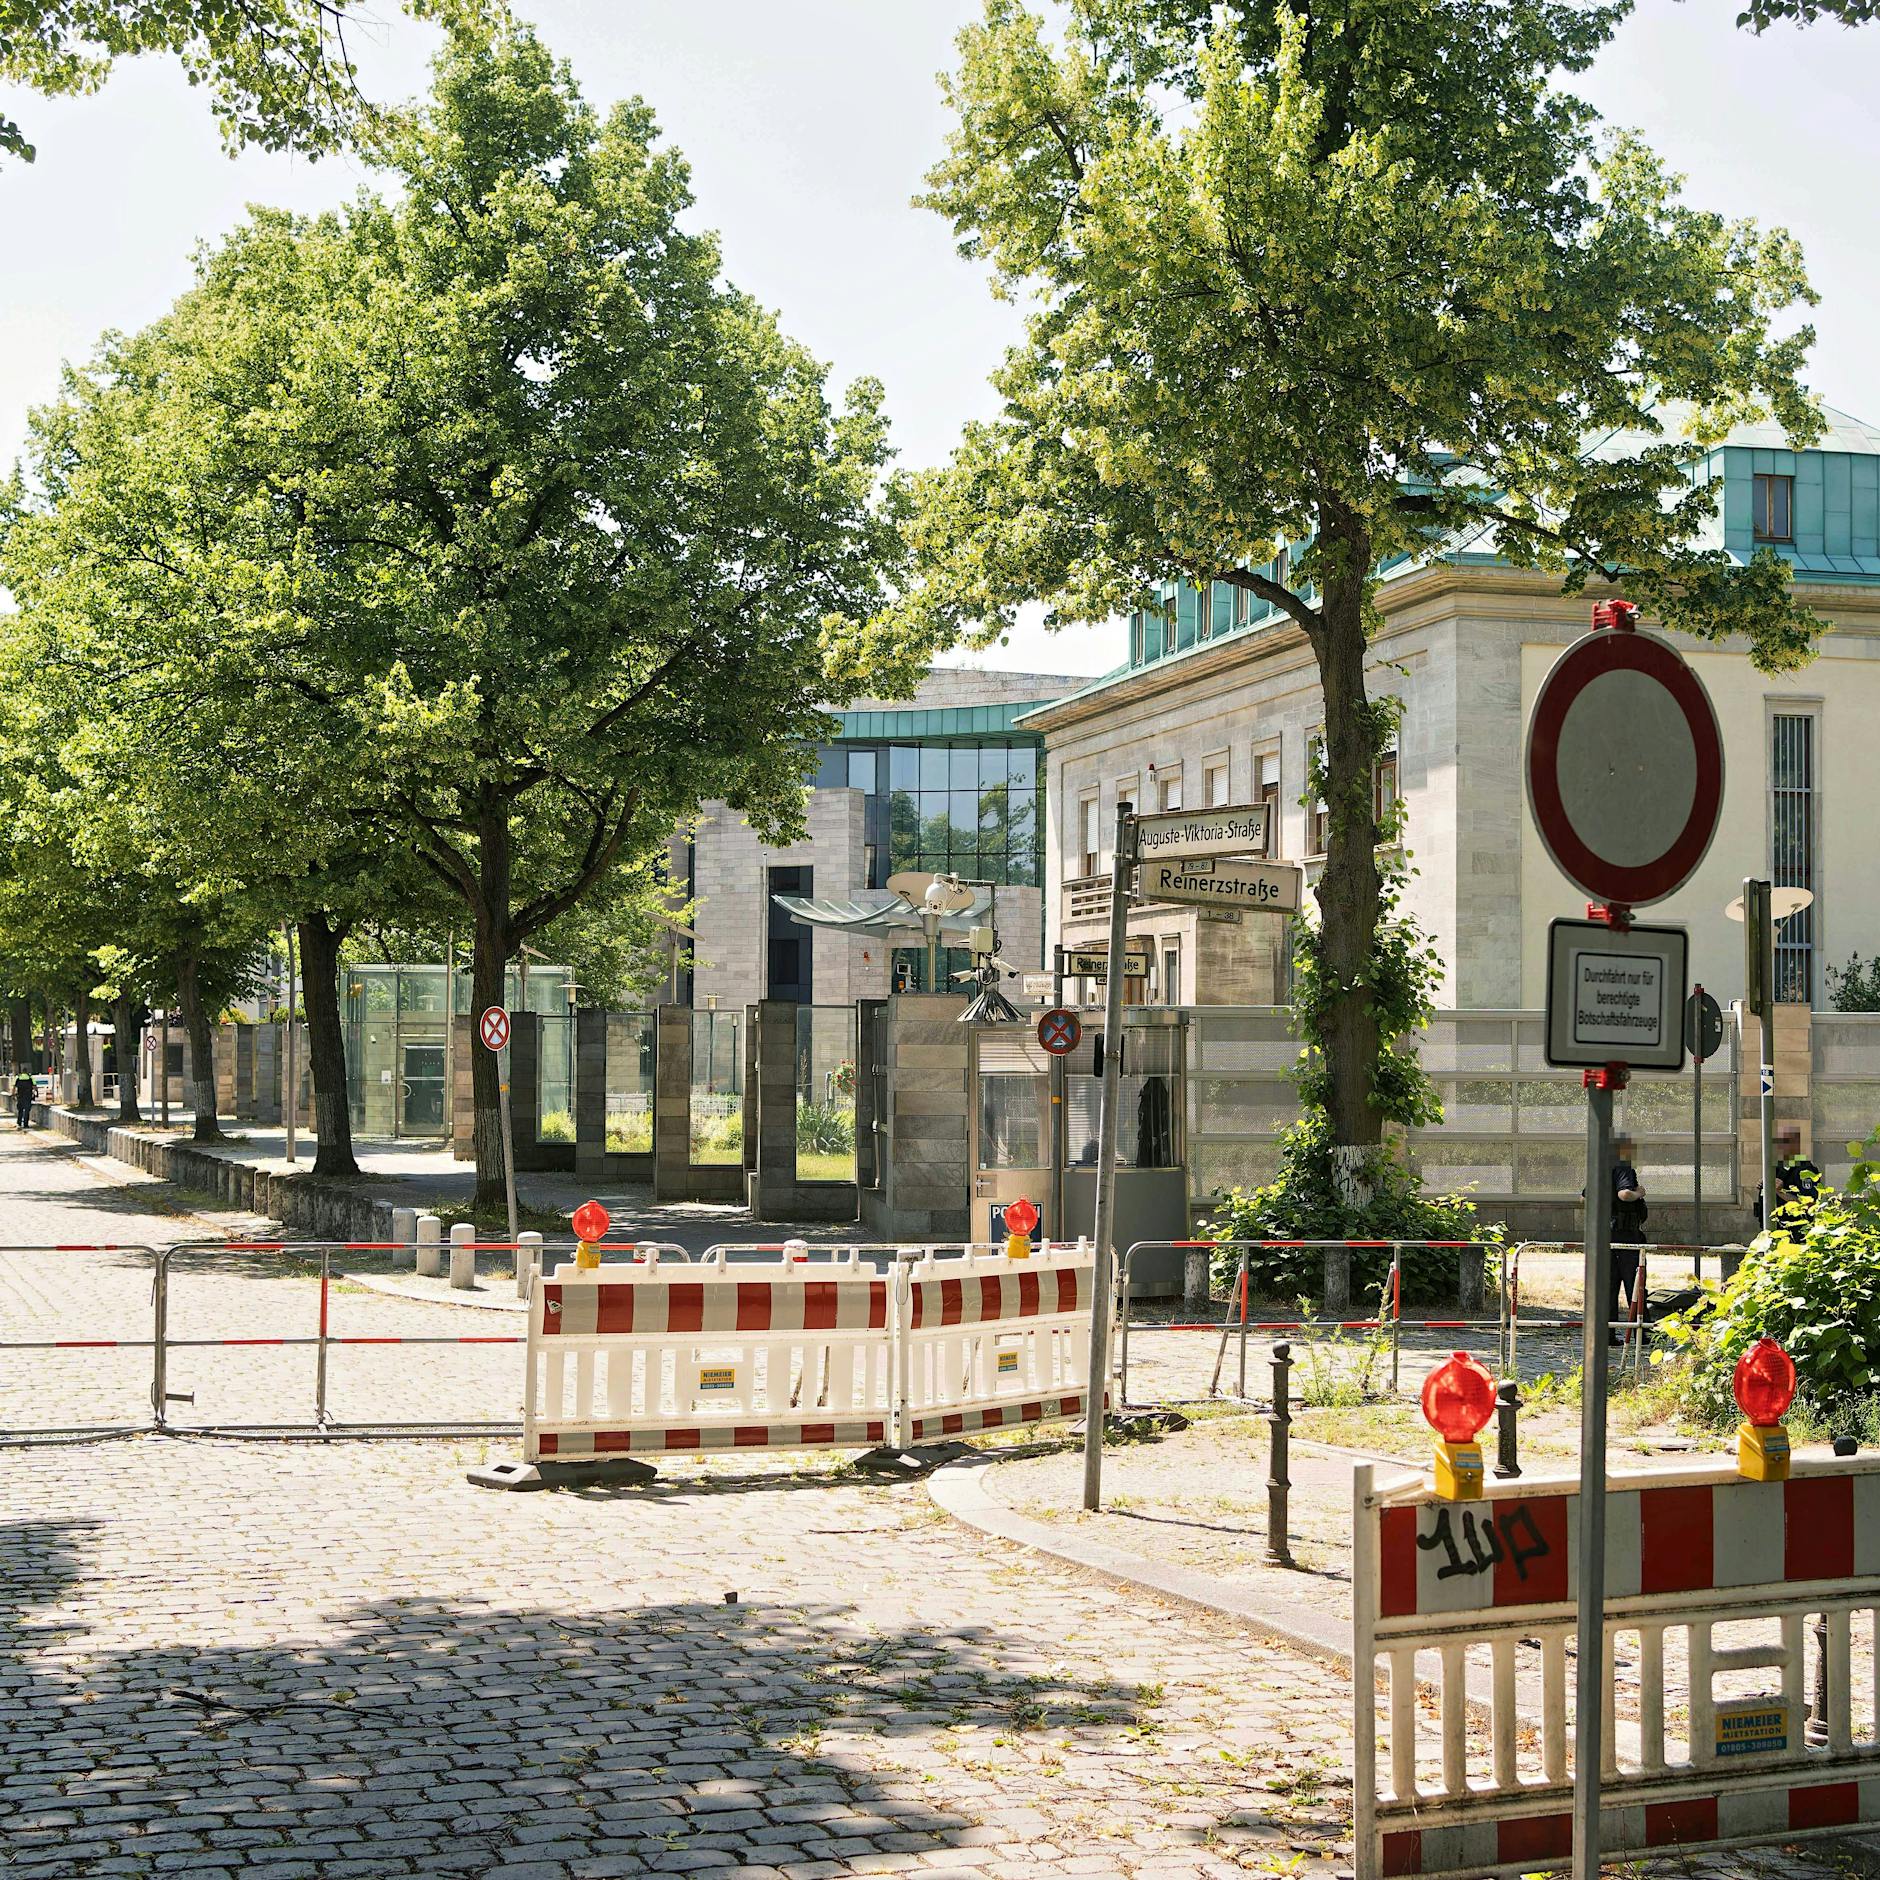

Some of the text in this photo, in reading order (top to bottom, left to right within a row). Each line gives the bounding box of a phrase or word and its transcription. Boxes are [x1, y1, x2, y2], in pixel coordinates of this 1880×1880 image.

[1139, 818, 1261, 850] Auguste-Viktoria-Straße
[1160, 868, 1279, 902] Reinerzstraße
[1584, 967, 1654, 986] Durchfahrt nur für
[1597, 990, 1640, 1010] berechtigte
[1578, 1010, 1657, 1032] Botschaftsfahrzeuge
[1722, 1714, 1782, 1730] NIEMEIER
[1723, 1727, 1781, 1739] MIETSTATION
